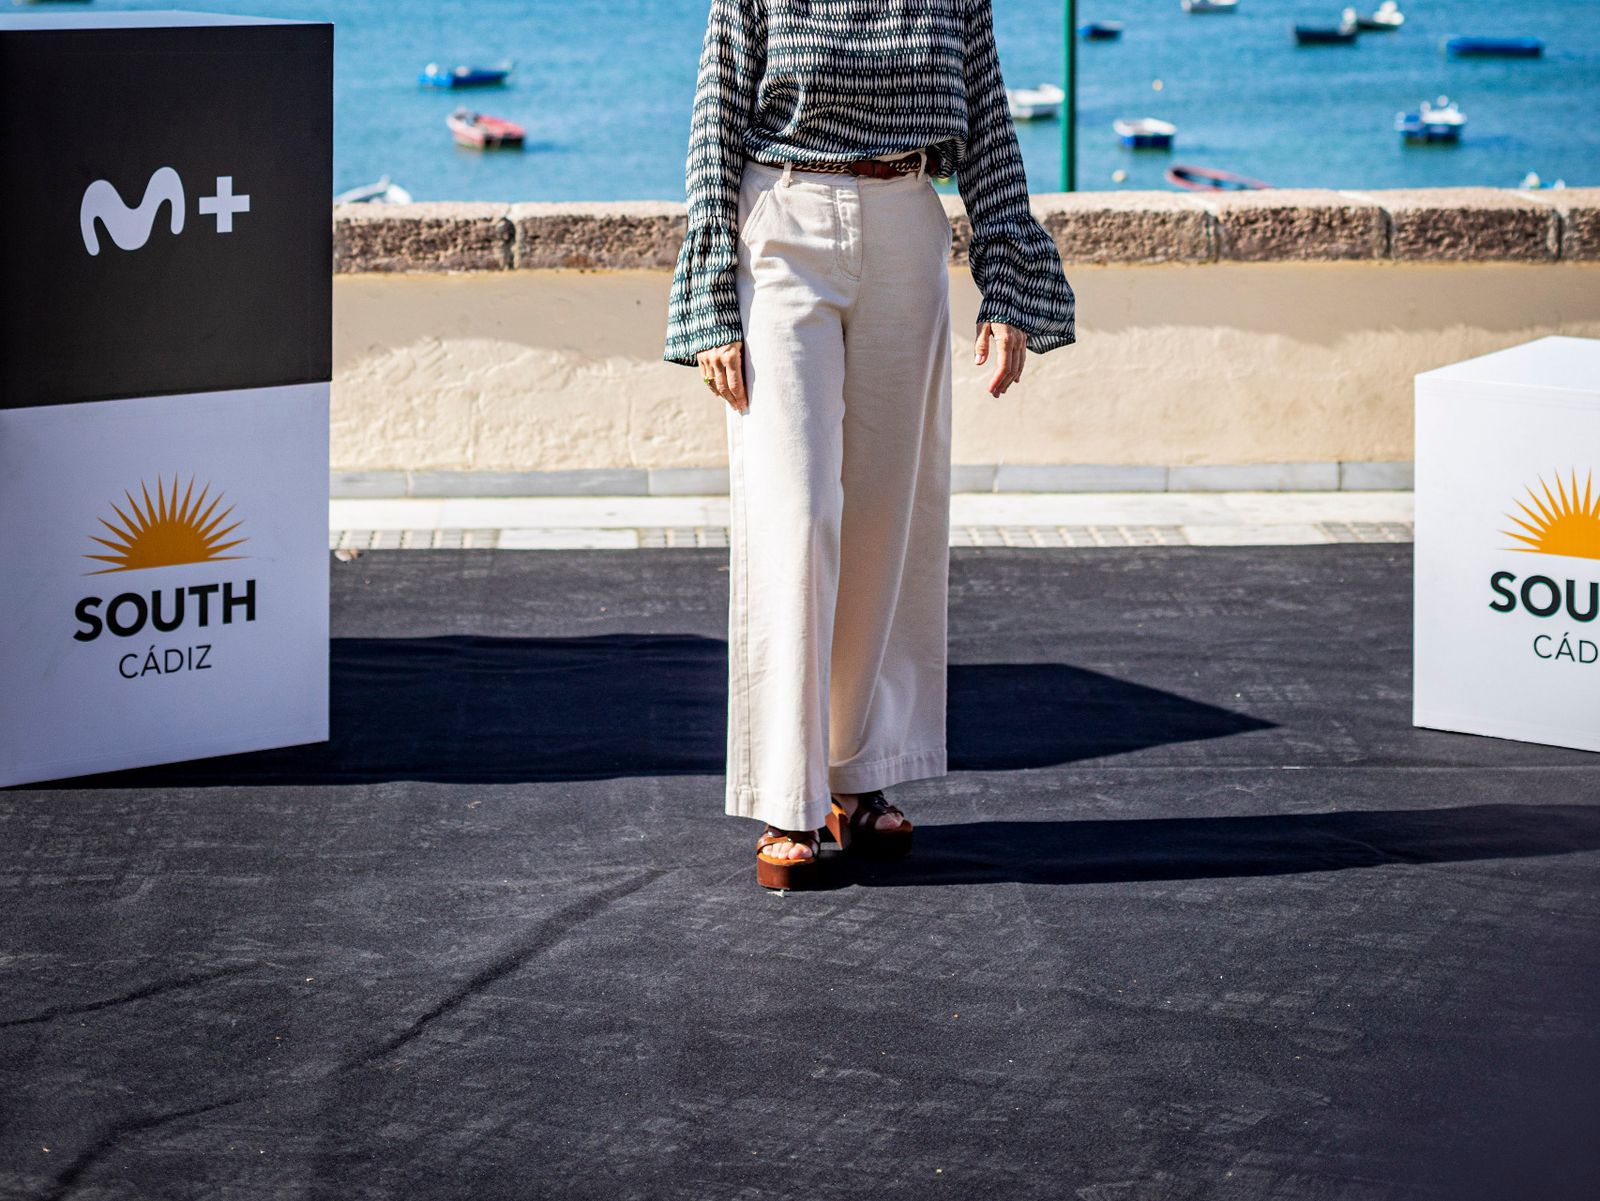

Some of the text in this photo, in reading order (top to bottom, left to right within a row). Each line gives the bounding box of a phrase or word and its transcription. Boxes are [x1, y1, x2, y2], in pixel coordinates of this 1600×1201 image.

[72, 578, 257, 643] SOUTH
[1488, 570, 1600, 623] SOU
[118, 643, 213, 680] CÁDIZ
[1533, 632, 1600, 665] CÁD
